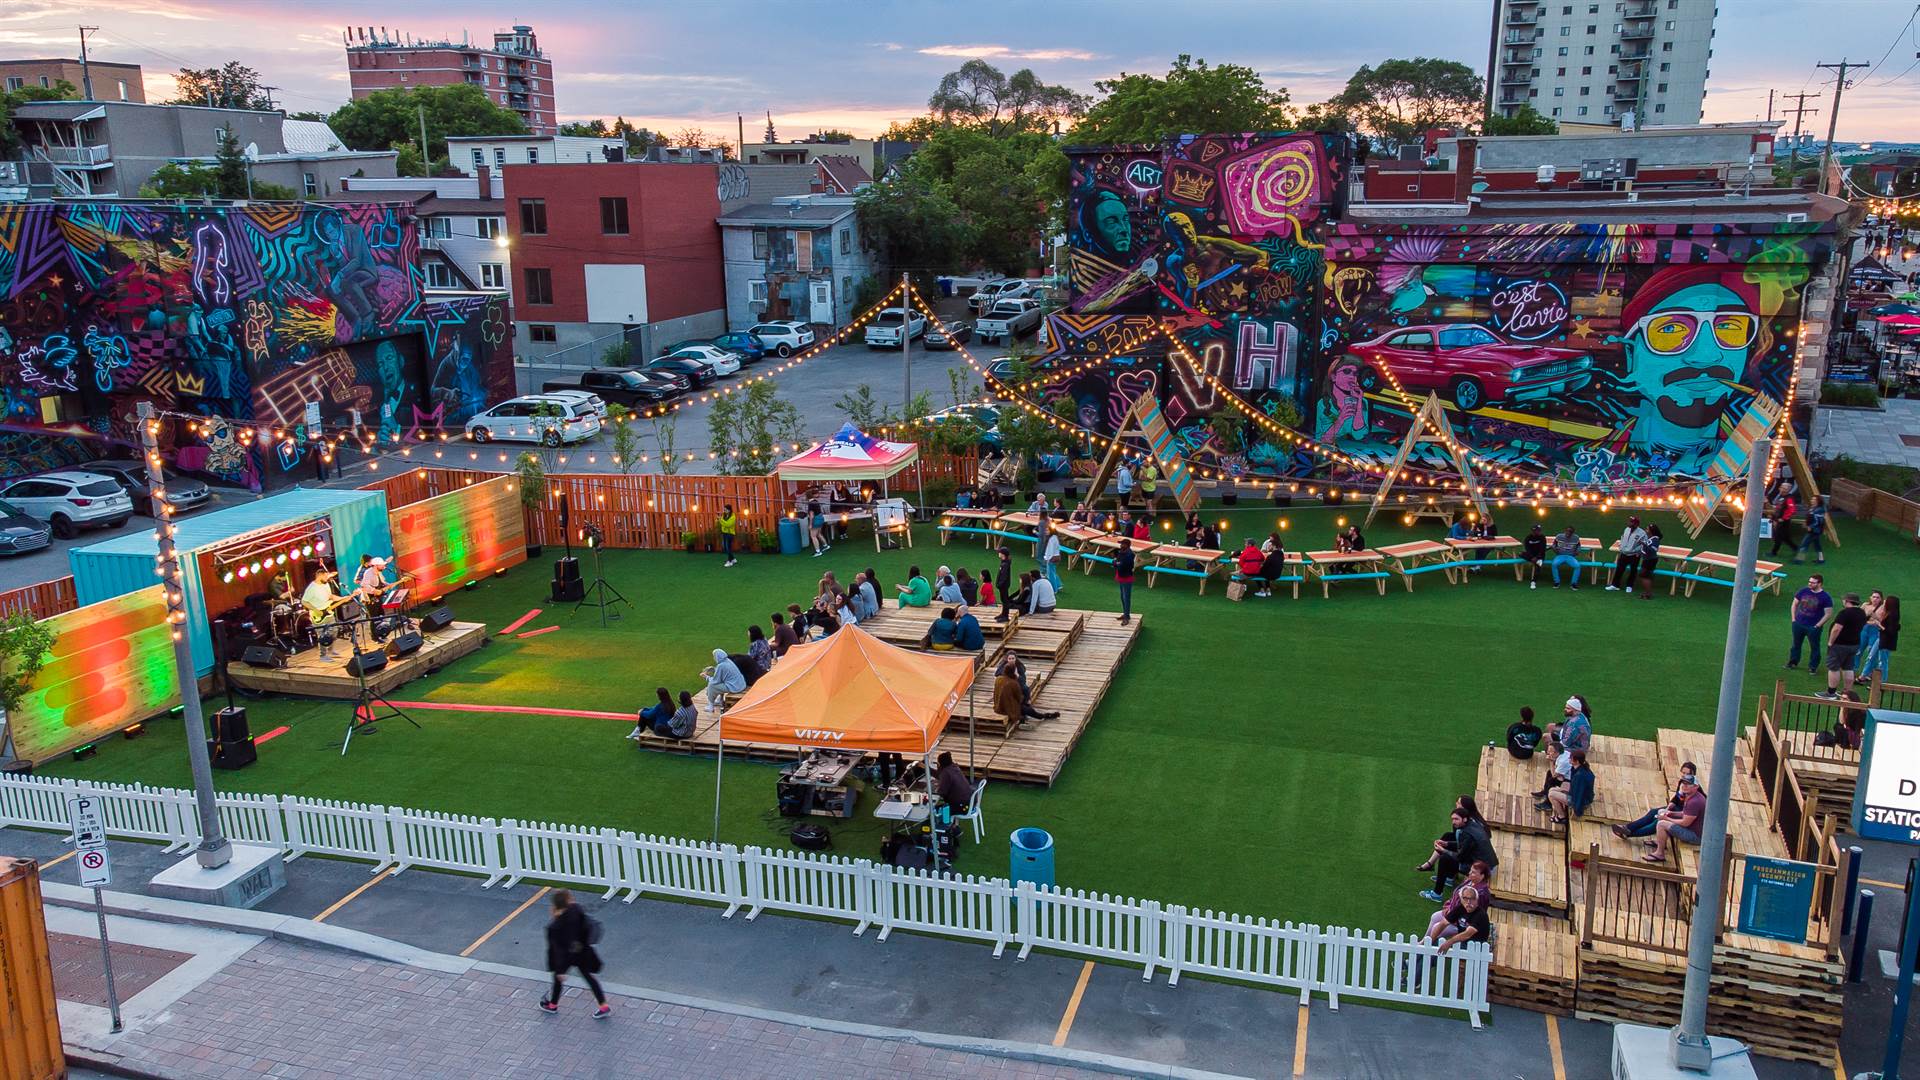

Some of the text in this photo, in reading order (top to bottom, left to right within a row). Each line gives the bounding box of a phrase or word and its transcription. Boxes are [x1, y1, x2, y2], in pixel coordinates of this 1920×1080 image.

[1129, 163, 1163, 185] ART
[1492, 281, 1546, 307] c'est
[79, 800, 91, 814] P
